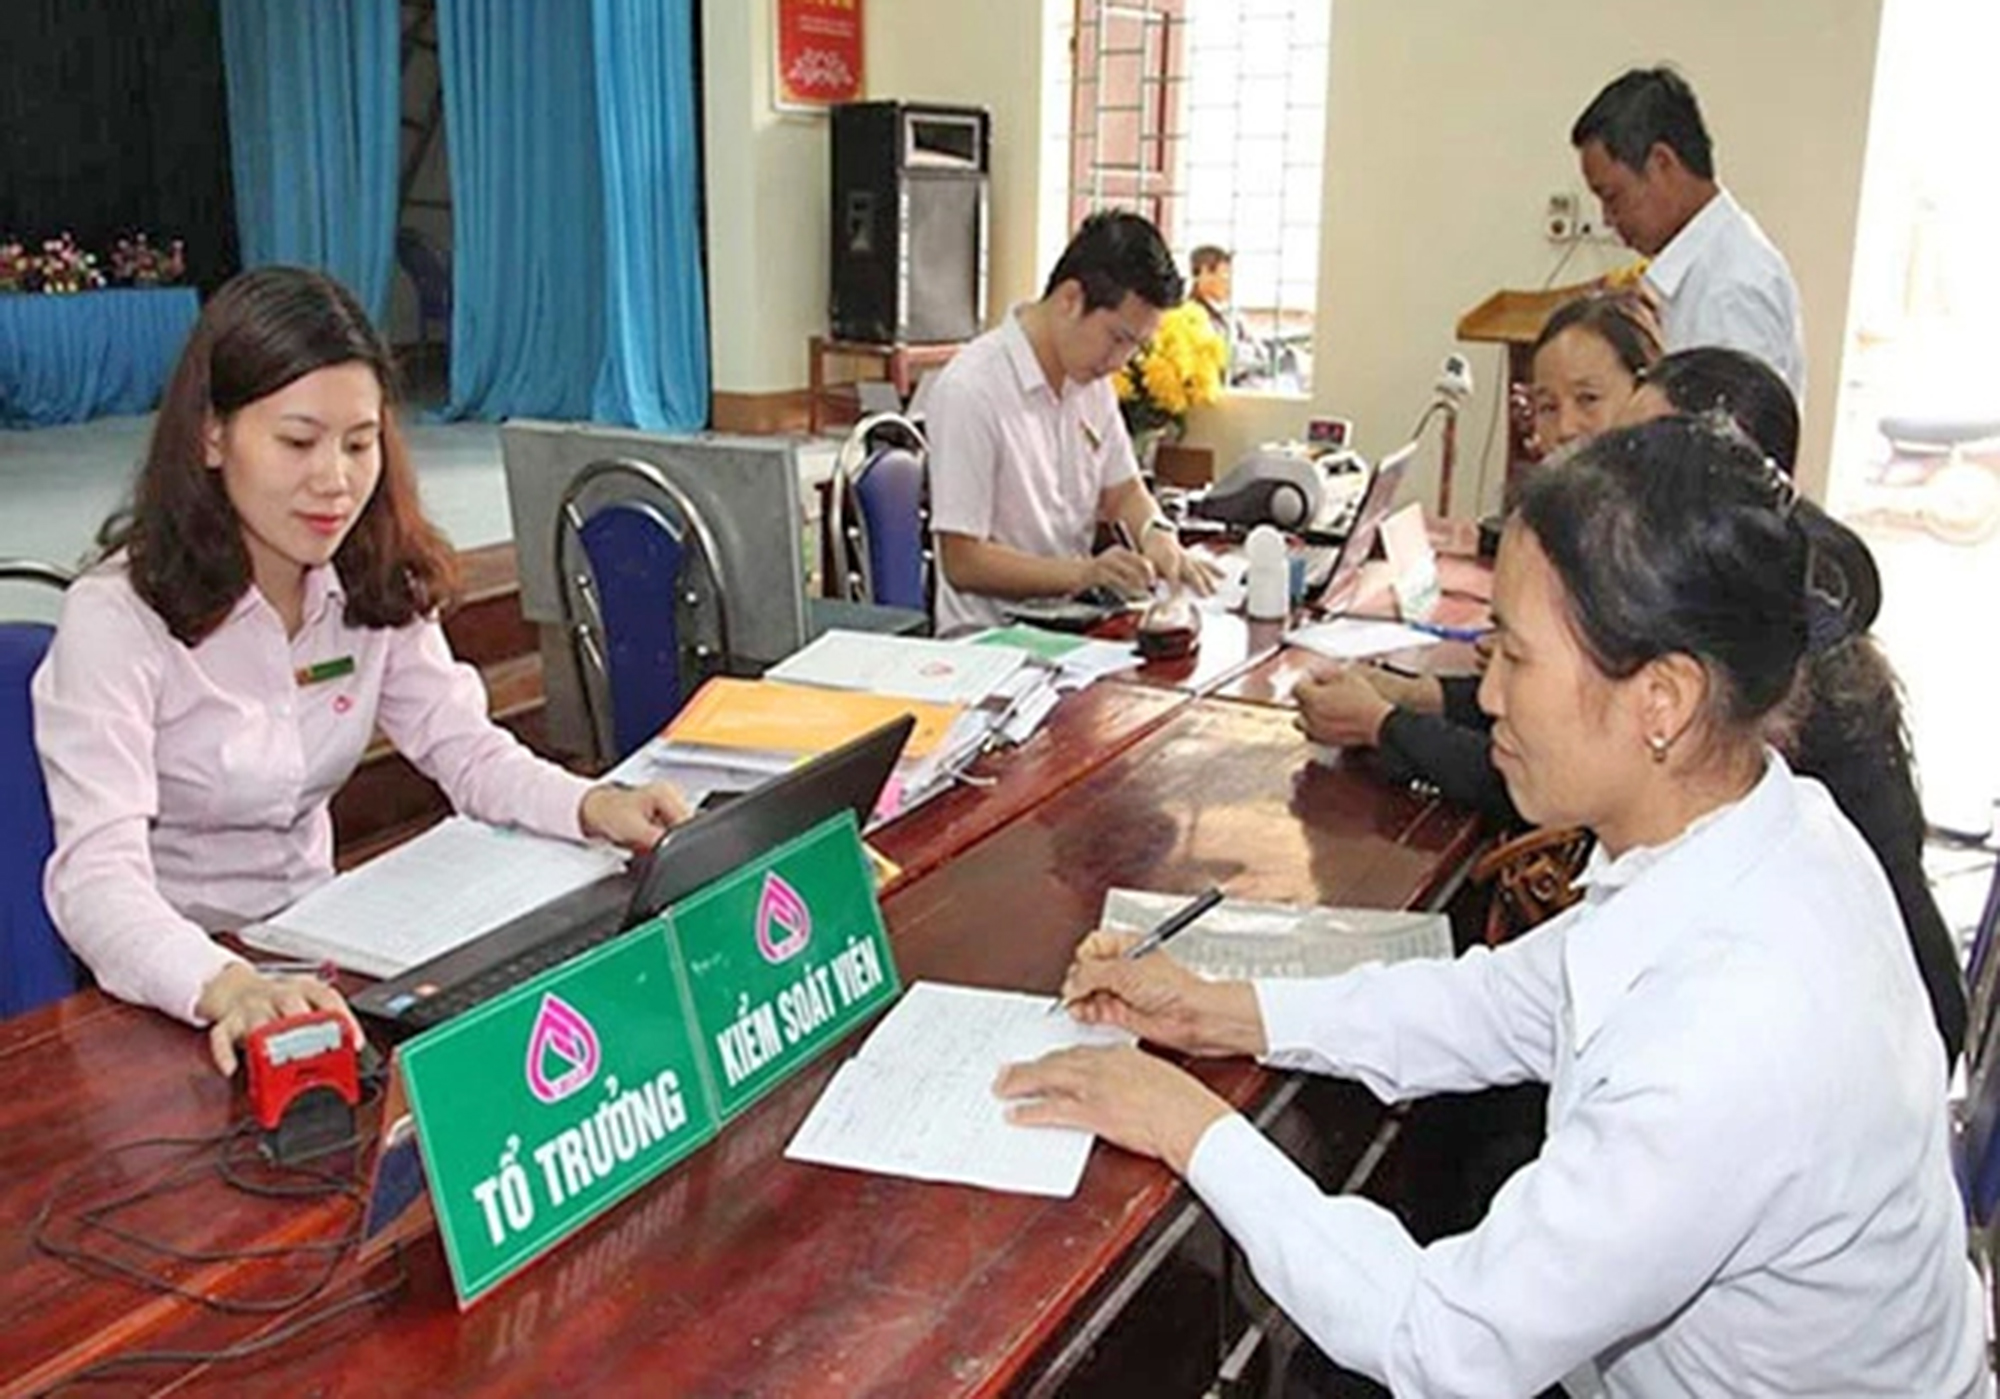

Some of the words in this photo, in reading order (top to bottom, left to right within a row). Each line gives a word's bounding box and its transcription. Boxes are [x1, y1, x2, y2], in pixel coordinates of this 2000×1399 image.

[716, 992, 783, 1087] KIỂM
[777, 963, 836, 1044] SOÁT
[830, 935, 883, 1006] VIÊN
[472, 1133, 535, 1247] TỔ
[533, 1069, 687, 1207] TRƯỞNG
